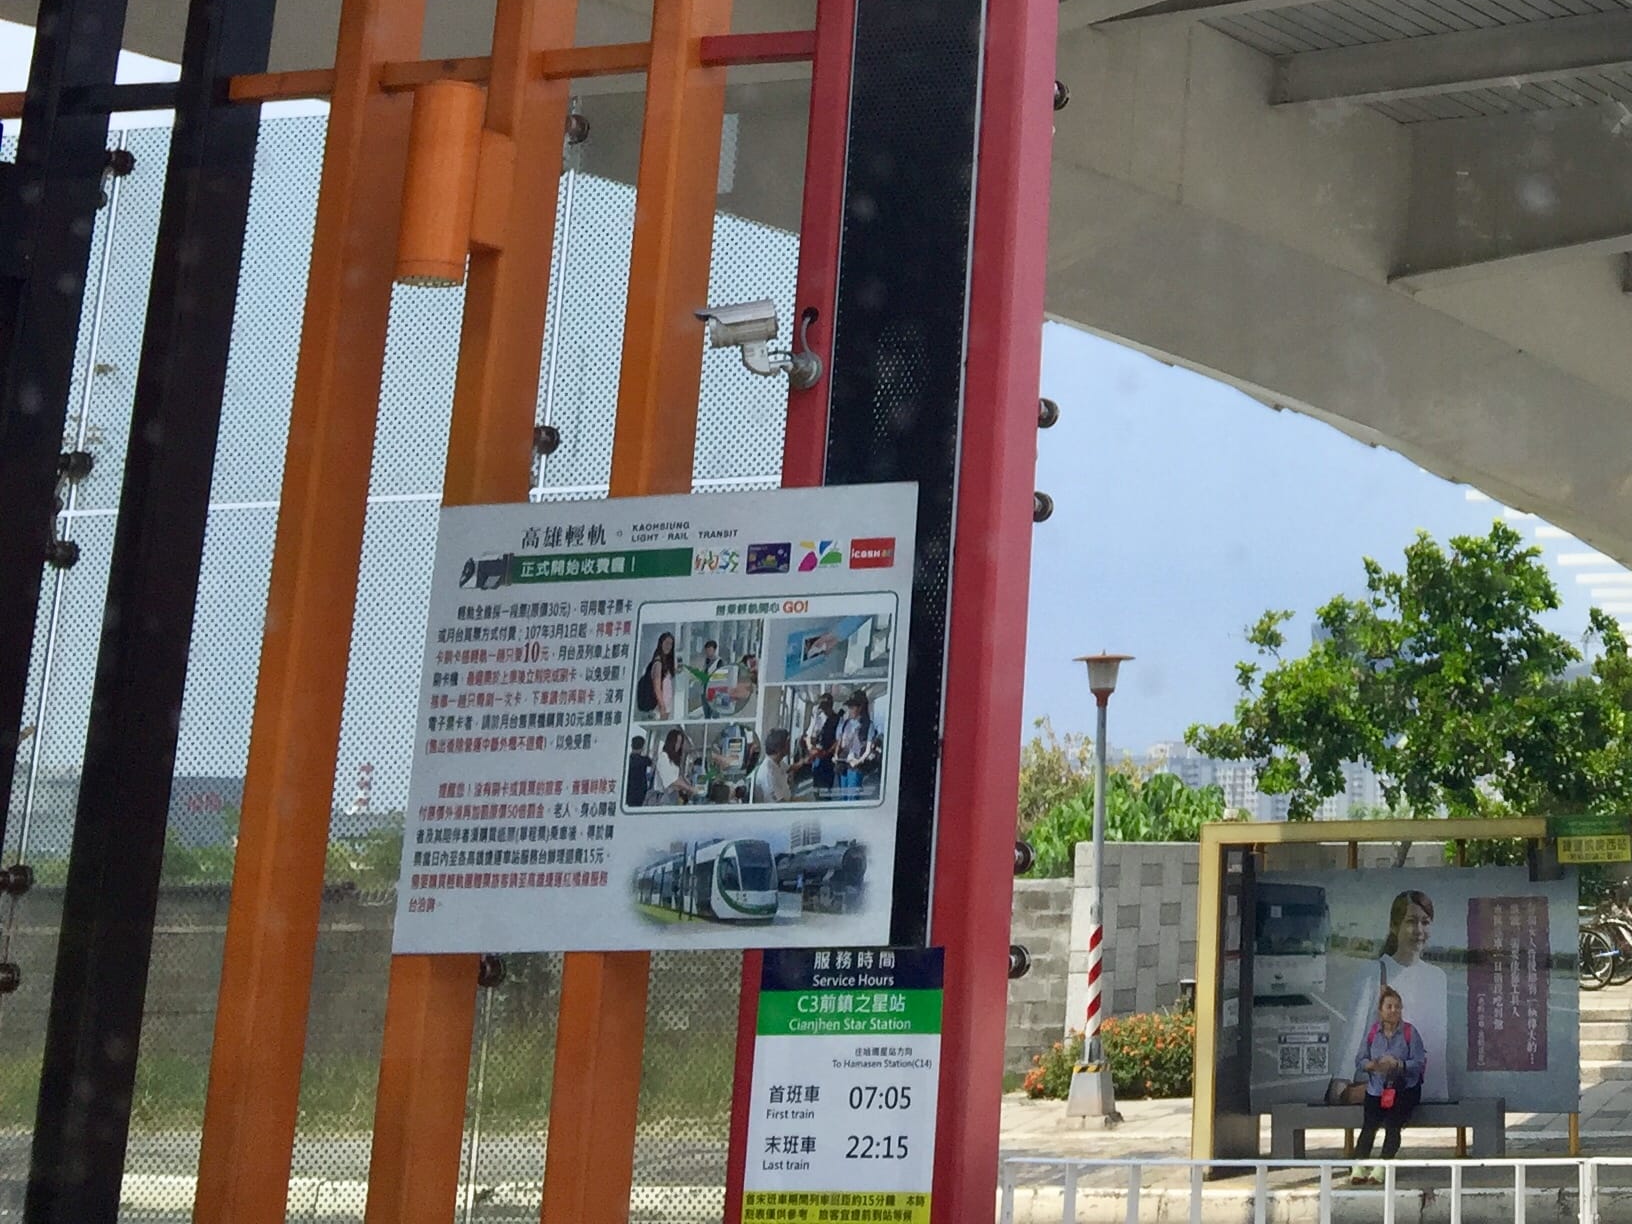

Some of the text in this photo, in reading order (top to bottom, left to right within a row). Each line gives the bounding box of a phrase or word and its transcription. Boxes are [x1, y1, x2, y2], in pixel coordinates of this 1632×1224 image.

[632, 521, 690, 532] KAOHSIUNG
[520, 524, 606, 549] 高雄輕軌
[631, 529, 738, 543] LIGHT RAIL TRANSIT
[782, 600, 809, 614] GO!
[813, 951, 896, 970] 服務時間
[812, 974, 895, 988] Service Hours
[797, 993, 907, 1015] C3前鎮之星站
[788, 1017, 912, 1034] Cianjhen Star Station
[768, 1084, 912, 1110] 首班車 07:05
[766, 1109, 815, 1120] First train
[764, 1135, 909, 1159] 末班車 22:15
[762, 1160, 810, 1171] Last train
